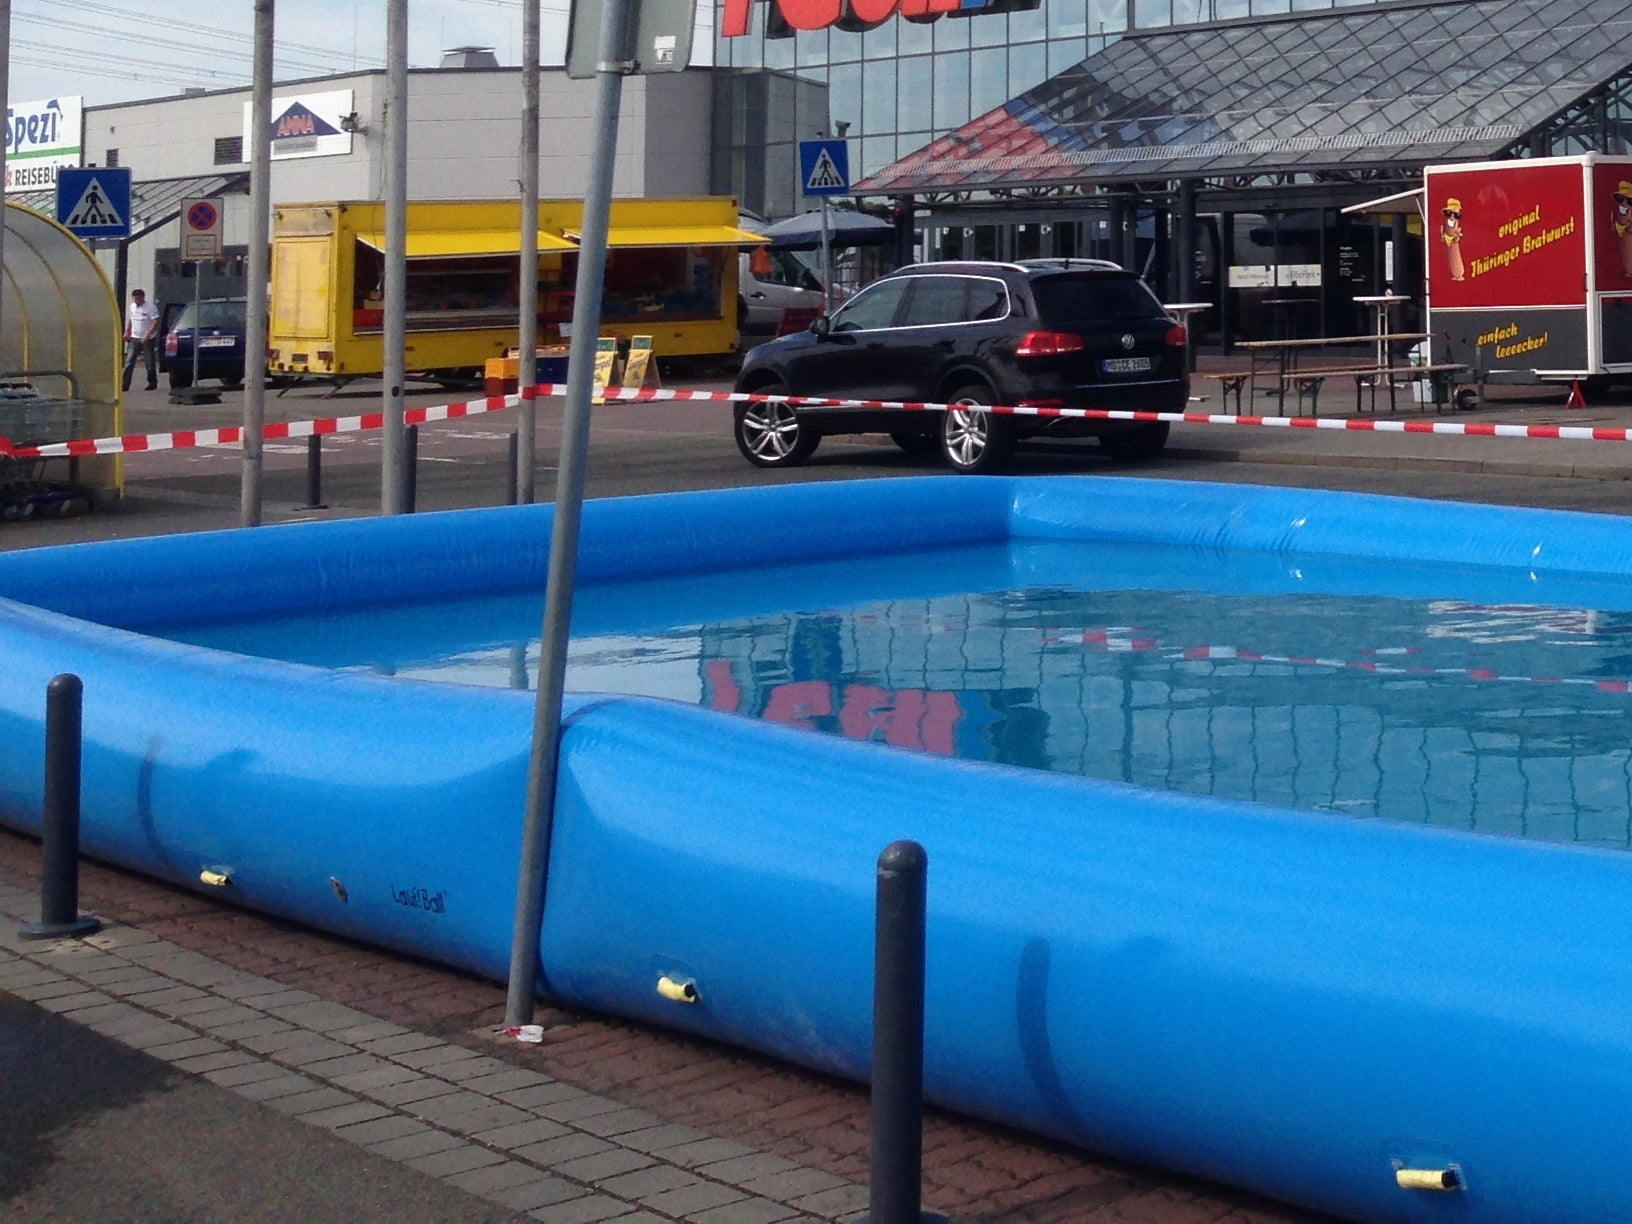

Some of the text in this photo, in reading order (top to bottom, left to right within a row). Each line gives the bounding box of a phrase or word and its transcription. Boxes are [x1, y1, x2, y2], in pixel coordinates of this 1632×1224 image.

[15, 161, 75, 186] REISEBÜ
[1498, 204, 1541, 238] original
[1470, 216, 1575, 278] Thüringer Bratwurst
[1477, 322, 1518, 345] einfach
